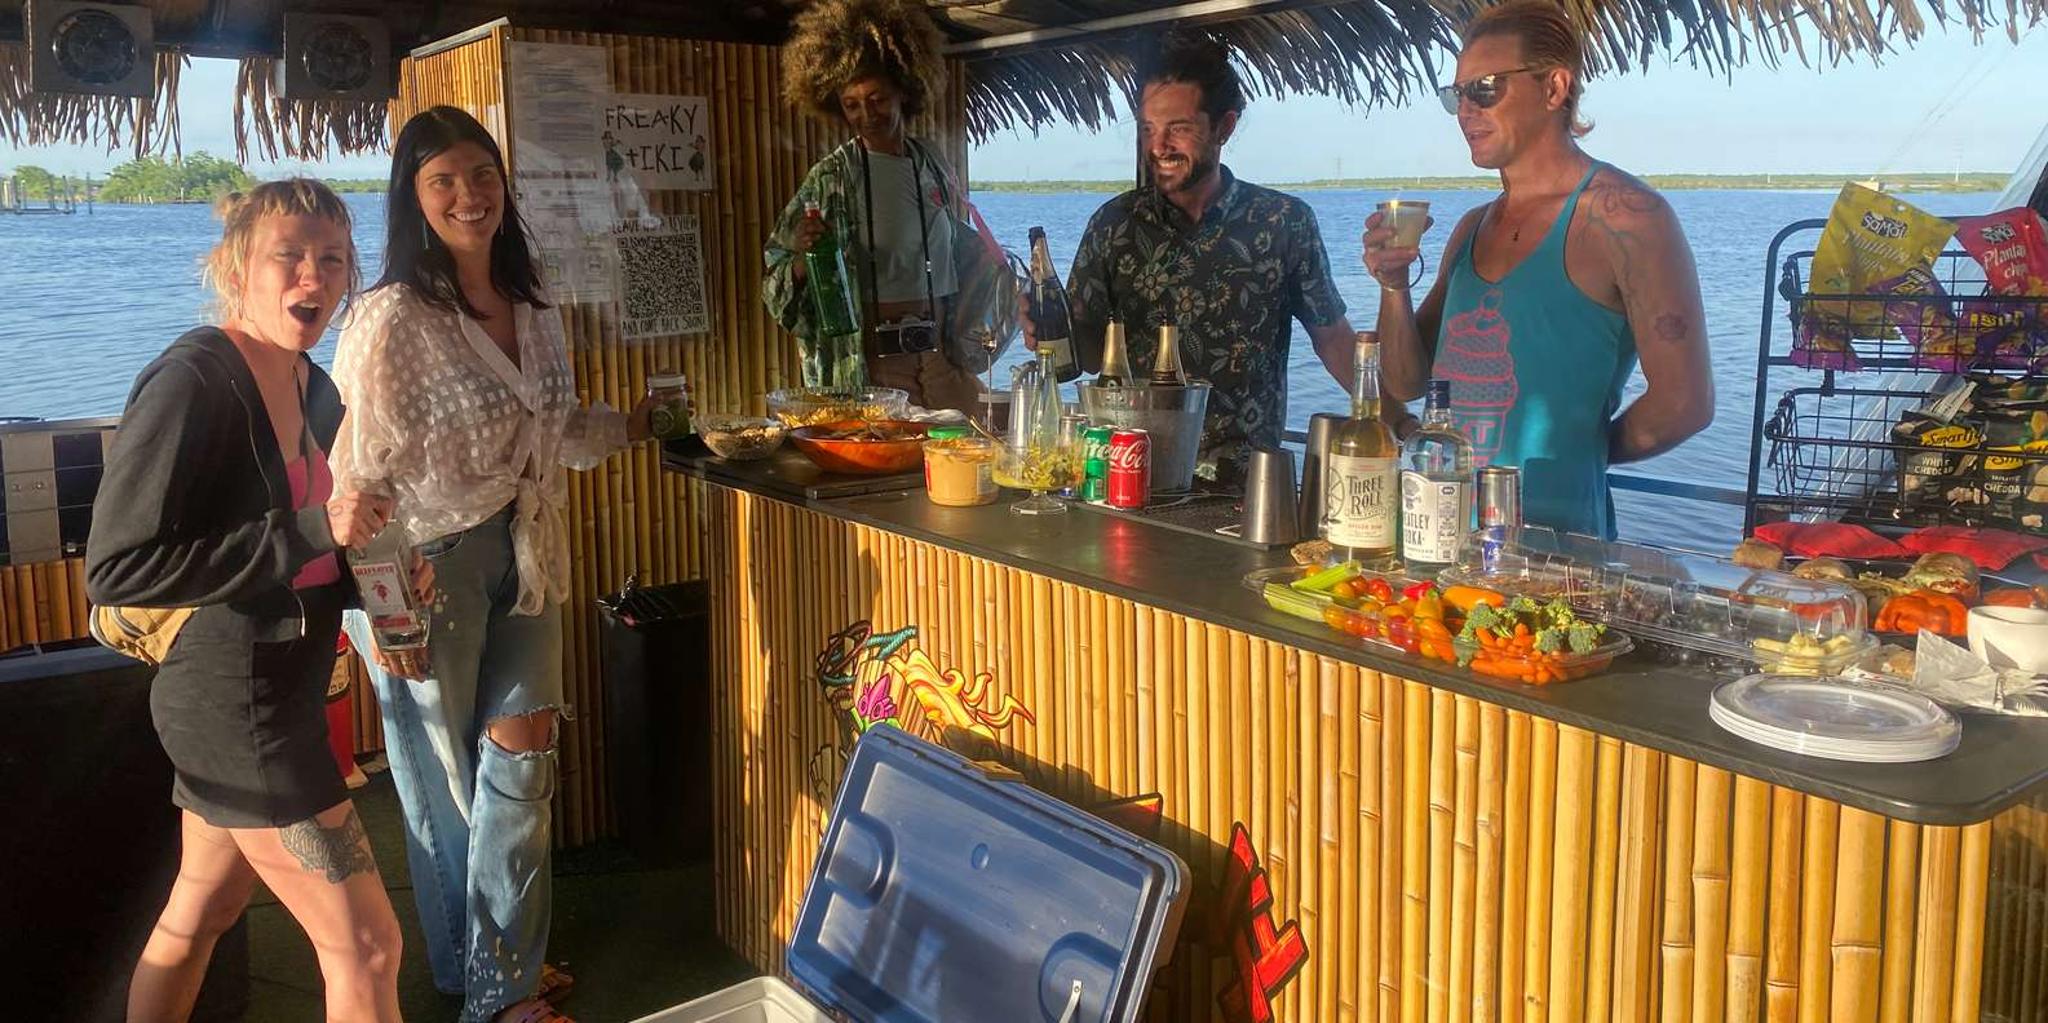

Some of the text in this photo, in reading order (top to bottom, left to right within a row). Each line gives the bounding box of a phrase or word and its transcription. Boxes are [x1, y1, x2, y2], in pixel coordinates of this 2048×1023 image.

[605, 104, 698, 135] FREAKY
[1345, 475, 1384, 495] THREE
[1350, 491, 1383, 515] ROLL
[1403, 512, 1430, 530] EATLEY
